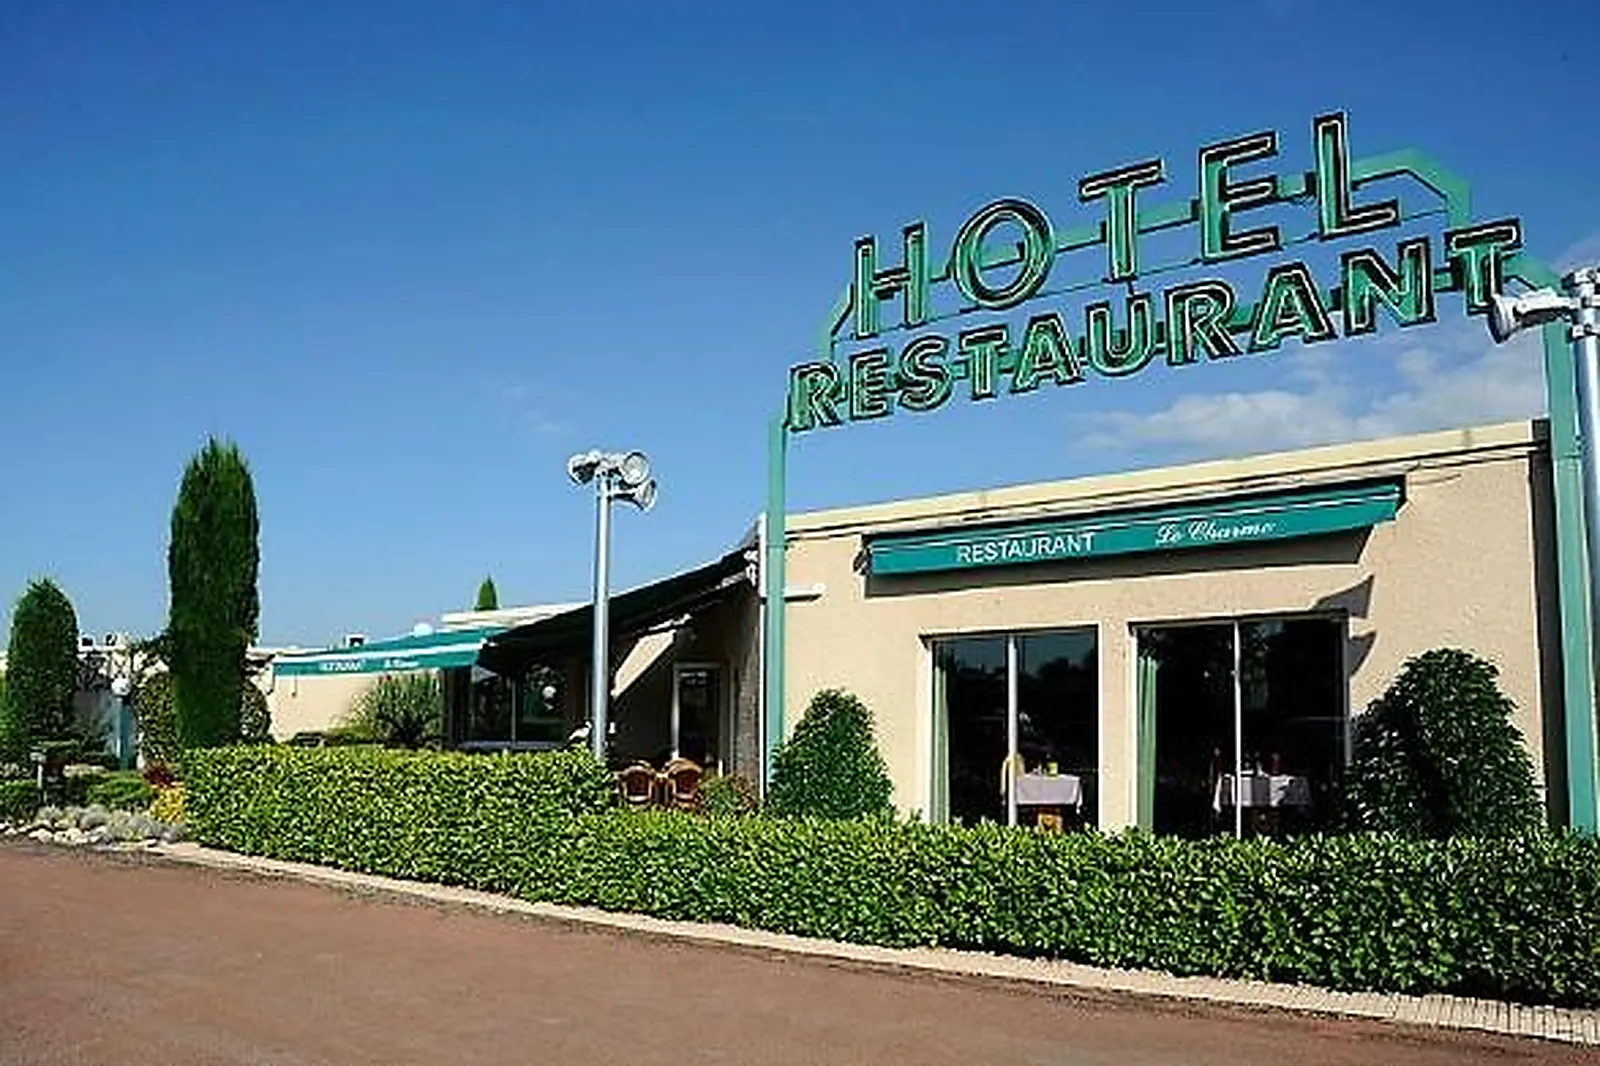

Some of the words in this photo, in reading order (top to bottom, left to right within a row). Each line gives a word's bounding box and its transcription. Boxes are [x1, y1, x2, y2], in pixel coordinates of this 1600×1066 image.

[787, 218, 1521, 432] RESTAURANT
[853, 111, 1398, 338] HOTEL
[957, 532, 1095, 564] RESTAURANT
